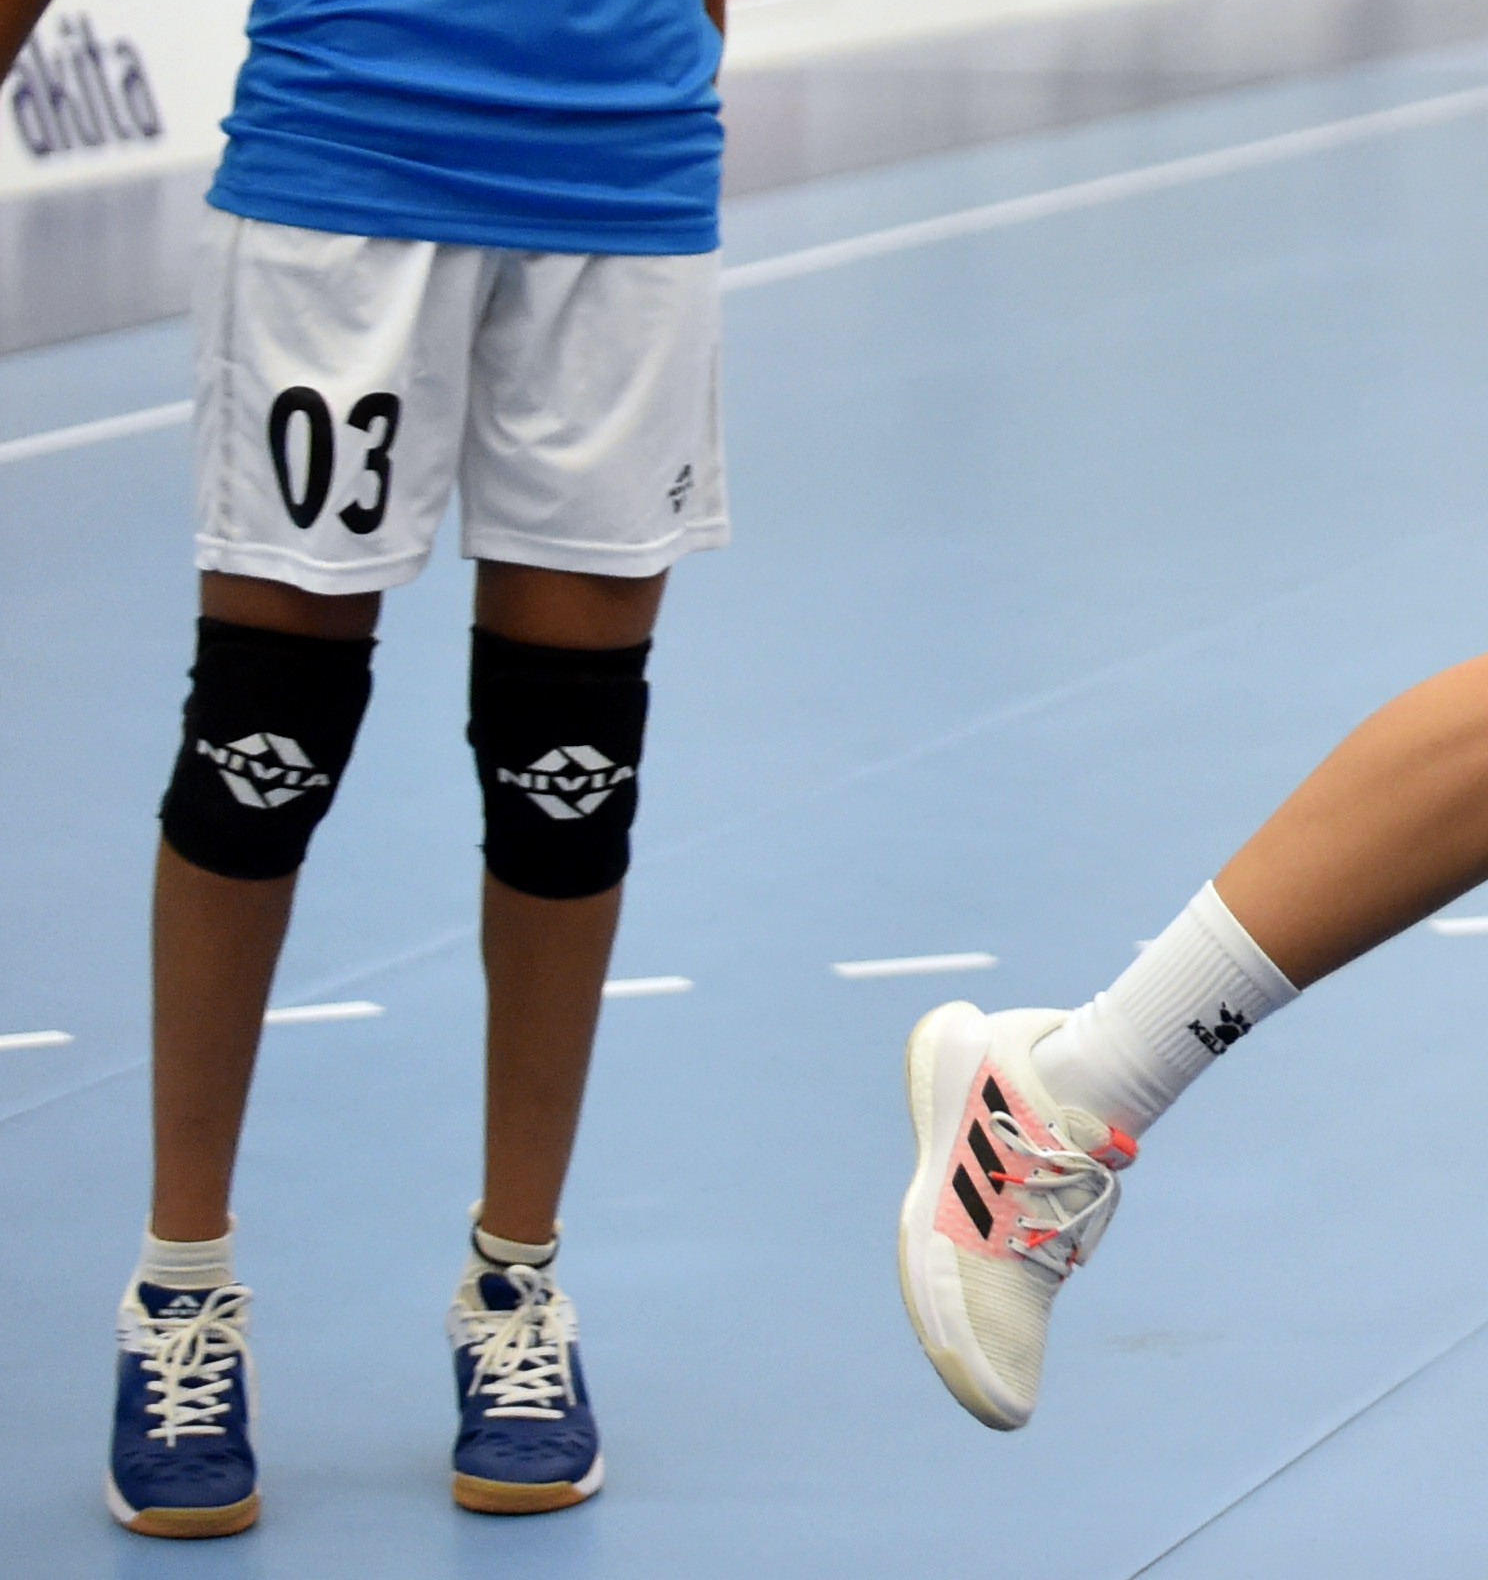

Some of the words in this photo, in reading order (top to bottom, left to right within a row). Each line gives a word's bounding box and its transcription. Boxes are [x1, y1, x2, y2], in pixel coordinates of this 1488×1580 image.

[268, 385, 402, 534] 03
[195, 738, 332, 788] NIVIA
[497, 764, 637, 790] NIVIA
